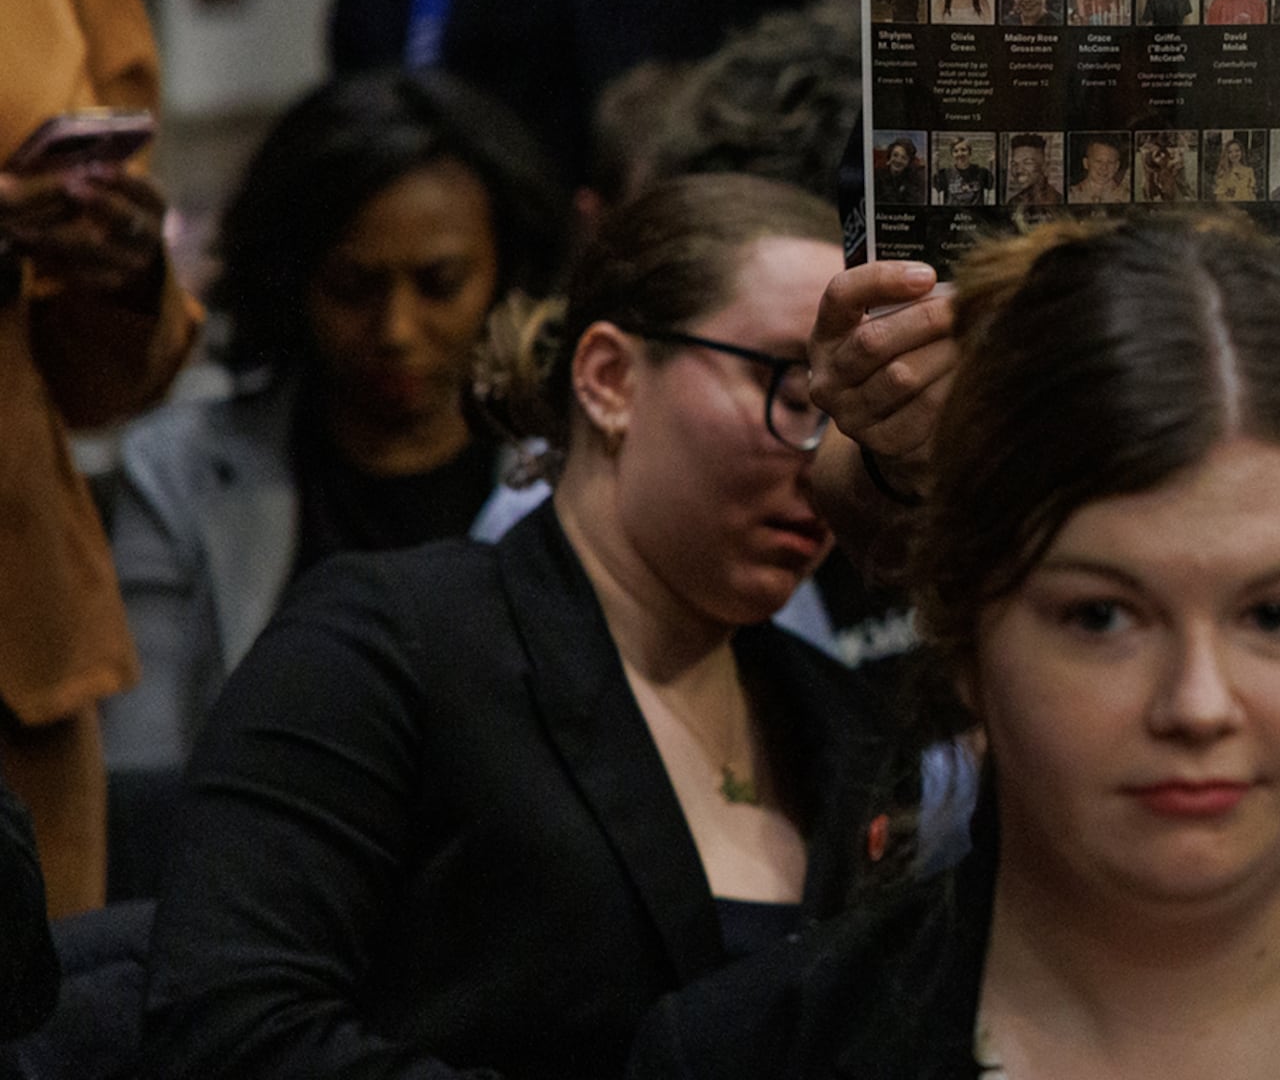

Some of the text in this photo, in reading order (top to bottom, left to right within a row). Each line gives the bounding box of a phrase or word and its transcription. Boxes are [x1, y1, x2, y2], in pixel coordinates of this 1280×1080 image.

[1087, 34, 1112, 42] Grace
[1223, 33, 1248, 41] David
[950, 43, 977, 52] Green
